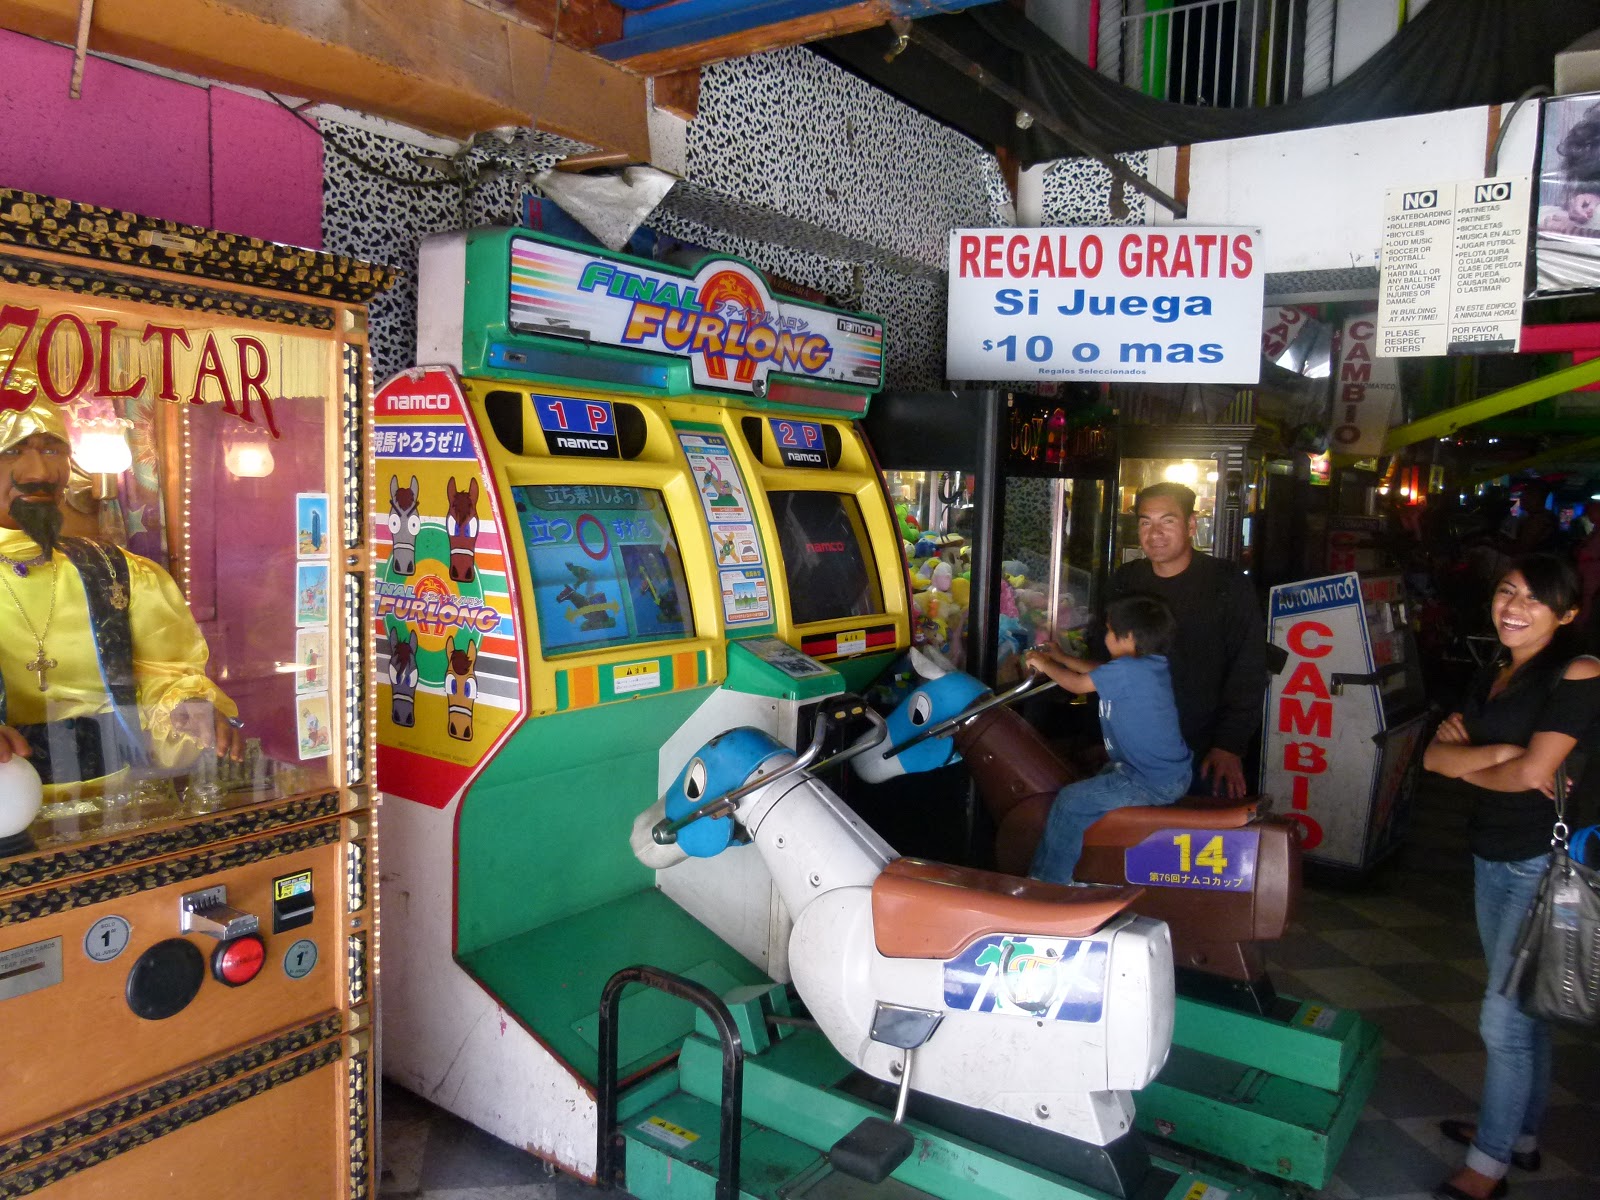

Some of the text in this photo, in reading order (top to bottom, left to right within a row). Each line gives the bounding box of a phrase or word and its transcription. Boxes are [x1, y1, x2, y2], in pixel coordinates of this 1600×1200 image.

[1476, 184, 1509, 202] NO
[1404, 191, 1435, 210] NO
[1461, 205, 1500, 214] PATINETAS
[1390, 210, 1452, 222] SKATEBOARDING
[1460, 215, 1491, 223] PATINES
[1390, 219, 1451, 230] ROLLERBLADING
[1460, 222, 1503, 232] BICICLETAS
[1390, 230, 1425, 238] BICYCLES
[1459, 232, 1488, 241] MUSICA
[1501, 229, 1521, 237] ALTO
[1389, 237, 1433, 247] LOUD MUSIC
[1459, 239, 1516, 250] JUGAR FUTBOL
[959, 234, 1253, 279] REGALO GRATIS
[1389, 247, 1419, 256] SOCCER
[1459, 248, 1510, 258] PELOTA DURA
[1388, 254, 1425, 262] FOOTBALL
[1464, 255, 1509, 264] CUALQUIER
[1388, 263, 1418, 271] PLAYING
[1458, 261, 1522, 272] CLASE DE PELOTA
[1457, 270, 1500, 280] QUE PUEDA
[578, 262, 702, 311] FINAL
[1411, 282, 1436, 290] CAUSE
[1457, 278, 1486, 287] CAUSAR
[1419, 289, 1431, 297] OR
[1464, 285, 1501, 293] LASTIMAR
[993, 288, 1212, 323] Si Juega
[1400, 307, 1437, 315] BUILDING
[1485, 302, 1516, 310] EDIFICIO
[839, 319, 874, 336] namco
[1471, 325, 1499, 333] FAVOR
[621, 302, 834, 374] FURLONG
[1385, 329, 1420, 338] PLEASE
[1452, 334, 1496, 342] RESPETEN
[1384, 337, 1426, 346] RESPECT
[982, 335, 1224, 364] $10 o mas
[1384, 345, 1421, 353] OTHERS
[0, 305, 281, 440] ZOLTAR
[1038, 367, 1147, 376] Regalos Seleccionados
[1334, 321, 1375, 444] CAMBIO
[387, 393, 451, 411] namco
[548, 402, 607, 431] 1 P
[779, 423, 818, 447] 2 P
[557, 436, 609, 451] namco
[787, 451, 821, 463] namco
[528, 515, 575, 545] 立つ
[805, 541, 845, 554] namco
[374, 581, 416, 599] INAL
[376, 596, 502, 634] FURLONG
[1279, 621, 1333, 849] CAMBIO
[1173, 833, 1228, 875] 14
[1149, 871, 1244, 888] 第76回ナムコカップ
